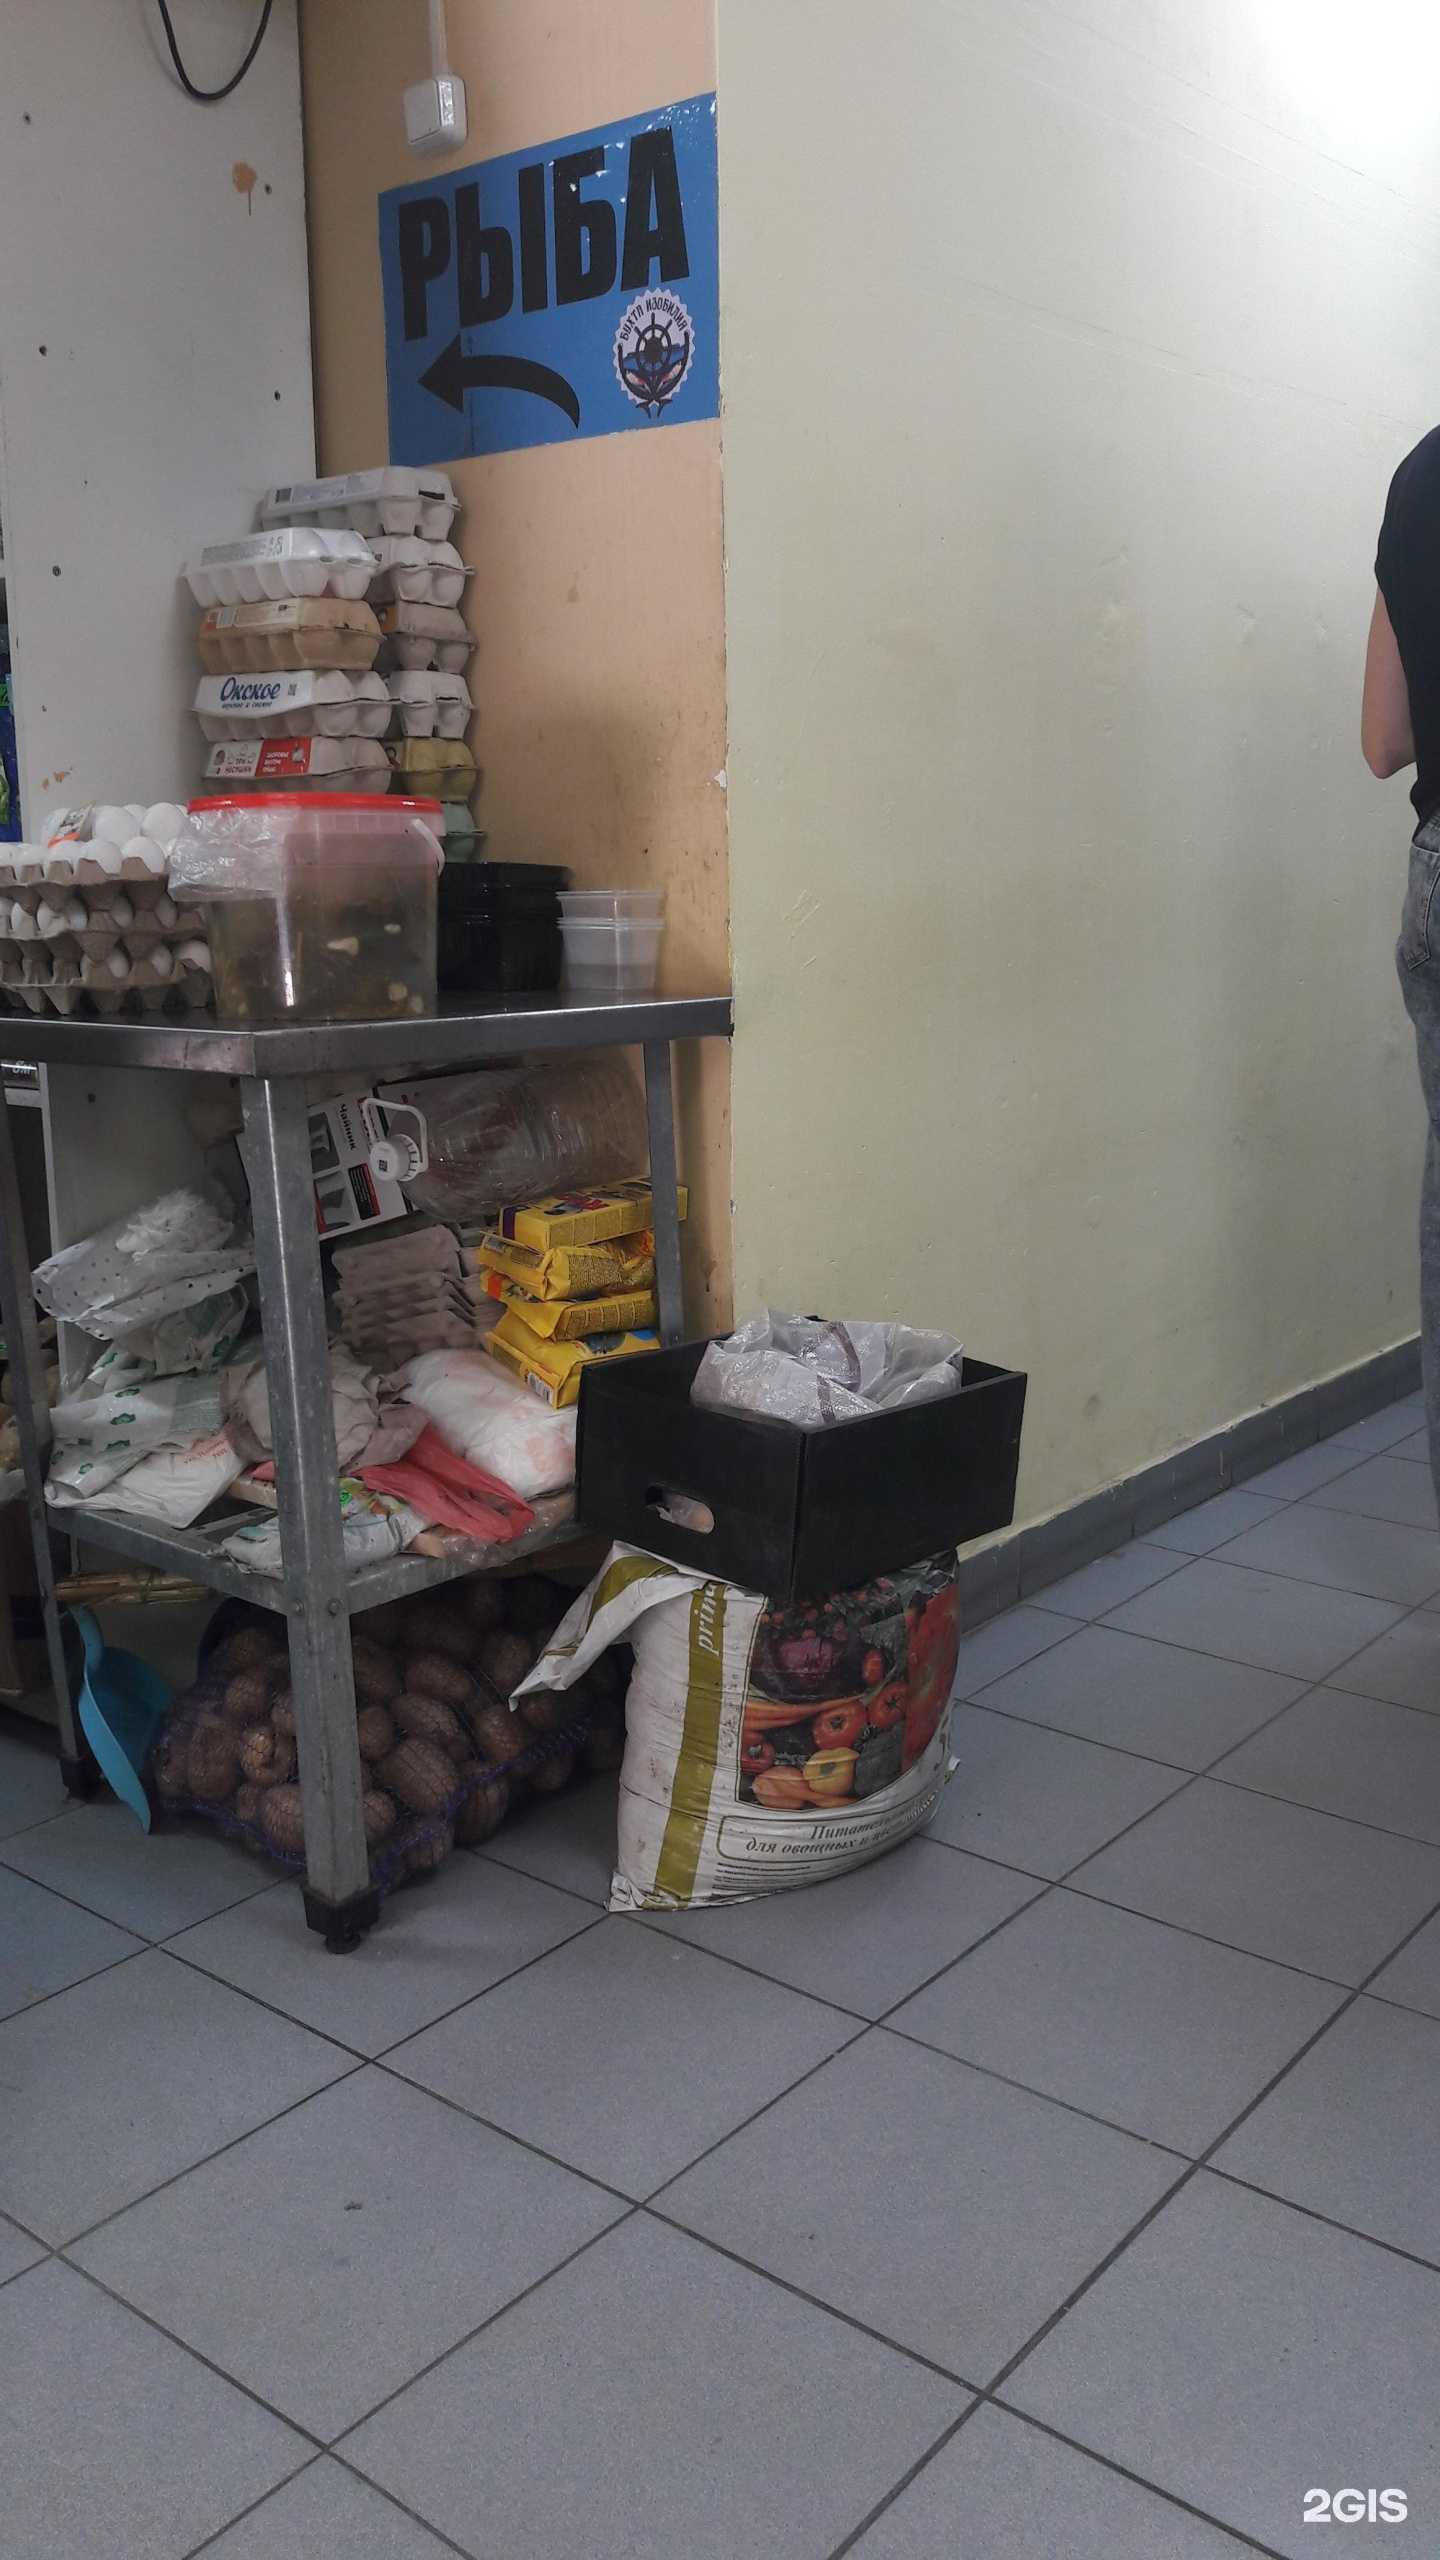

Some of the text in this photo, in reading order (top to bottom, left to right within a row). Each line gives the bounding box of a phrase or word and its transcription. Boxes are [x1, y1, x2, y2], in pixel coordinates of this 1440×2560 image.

[399, 126, 690, 342] РЫБА
[220, 677, 281, 702] Окское
[340, 1103, 357, 1151] Чайник
[745, 1836, 777, 1854] для
[781, 1837, 857, 1855] овощных
